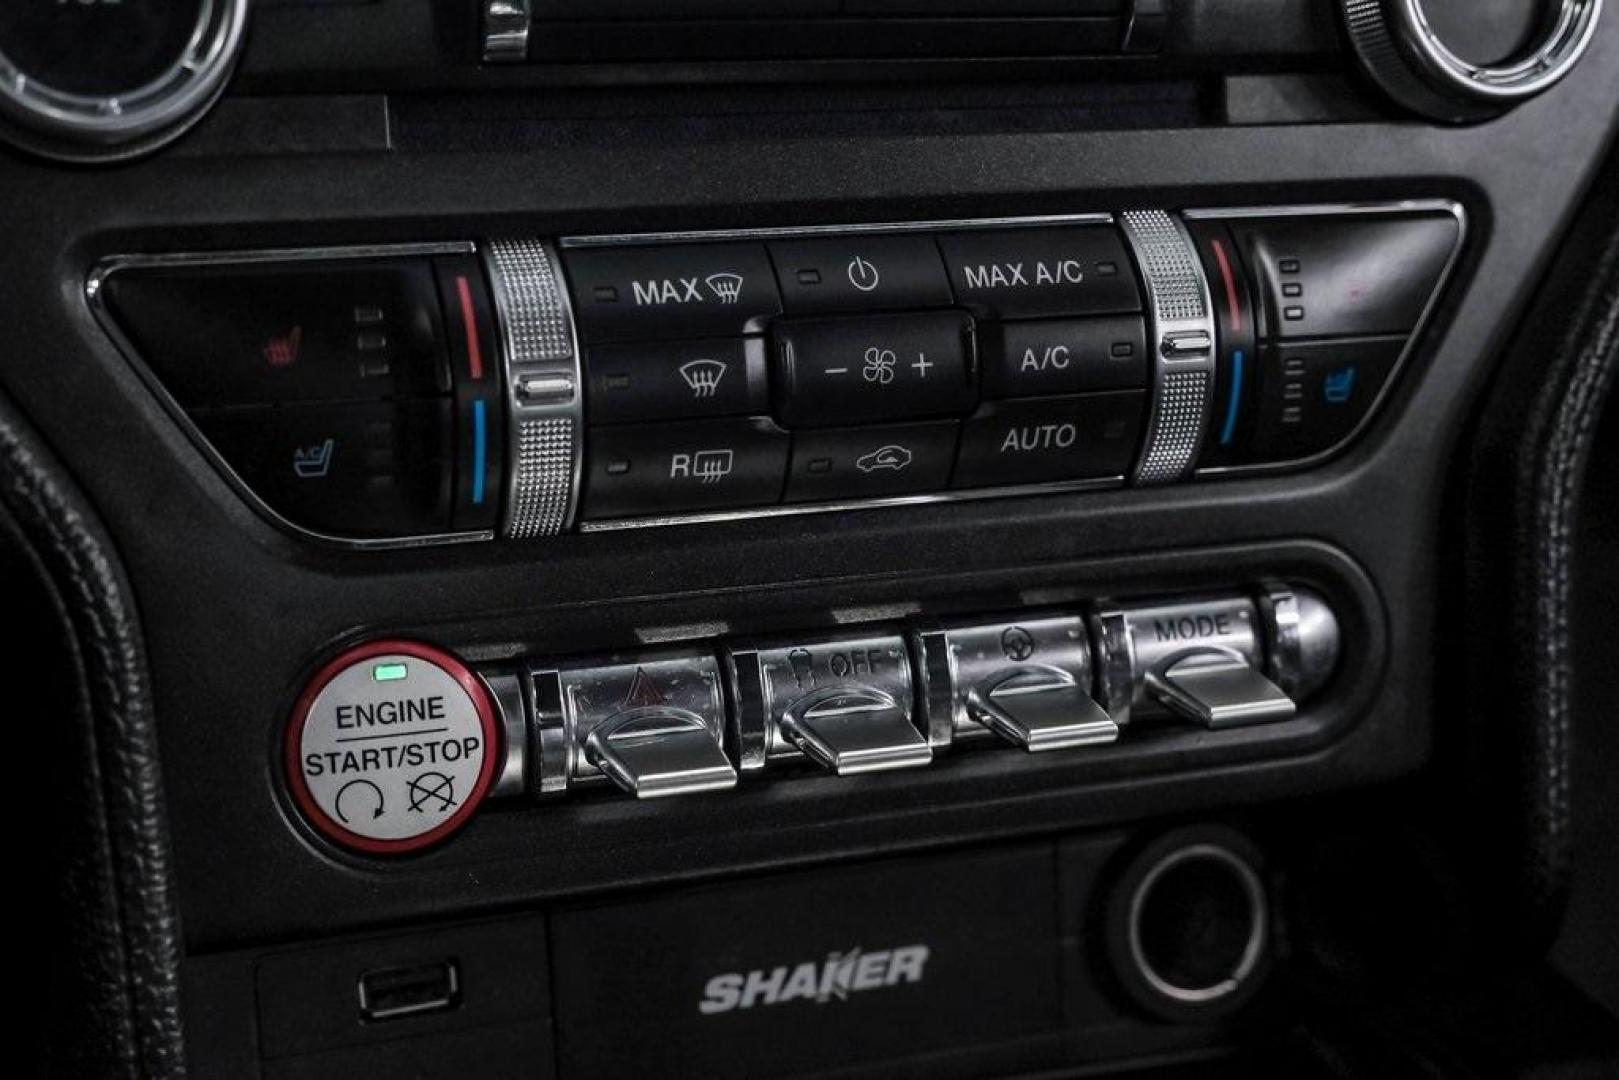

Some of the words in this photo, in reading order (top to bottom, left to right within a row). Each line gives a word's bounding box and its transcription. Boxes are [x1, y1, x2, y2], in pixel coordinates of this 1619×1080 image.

[964, 264, 1028, 288] MAX
[1036, 260, 1084, 285] A/C
[632, 278, 702, 305] MAX
[1021, 345, 1070, 370] A/C
[1001, 425, 1076, 453] AUTO
[671, 455, 688, 478] R
[1154, 613, 1229, 642] MODE
[830, 647, 883, 679] OFF
[336, 696, 445, 729] ENGINE
[306, 736, 480, 776] START/STOP
[698, 944, 930, 1014] SHAKER
